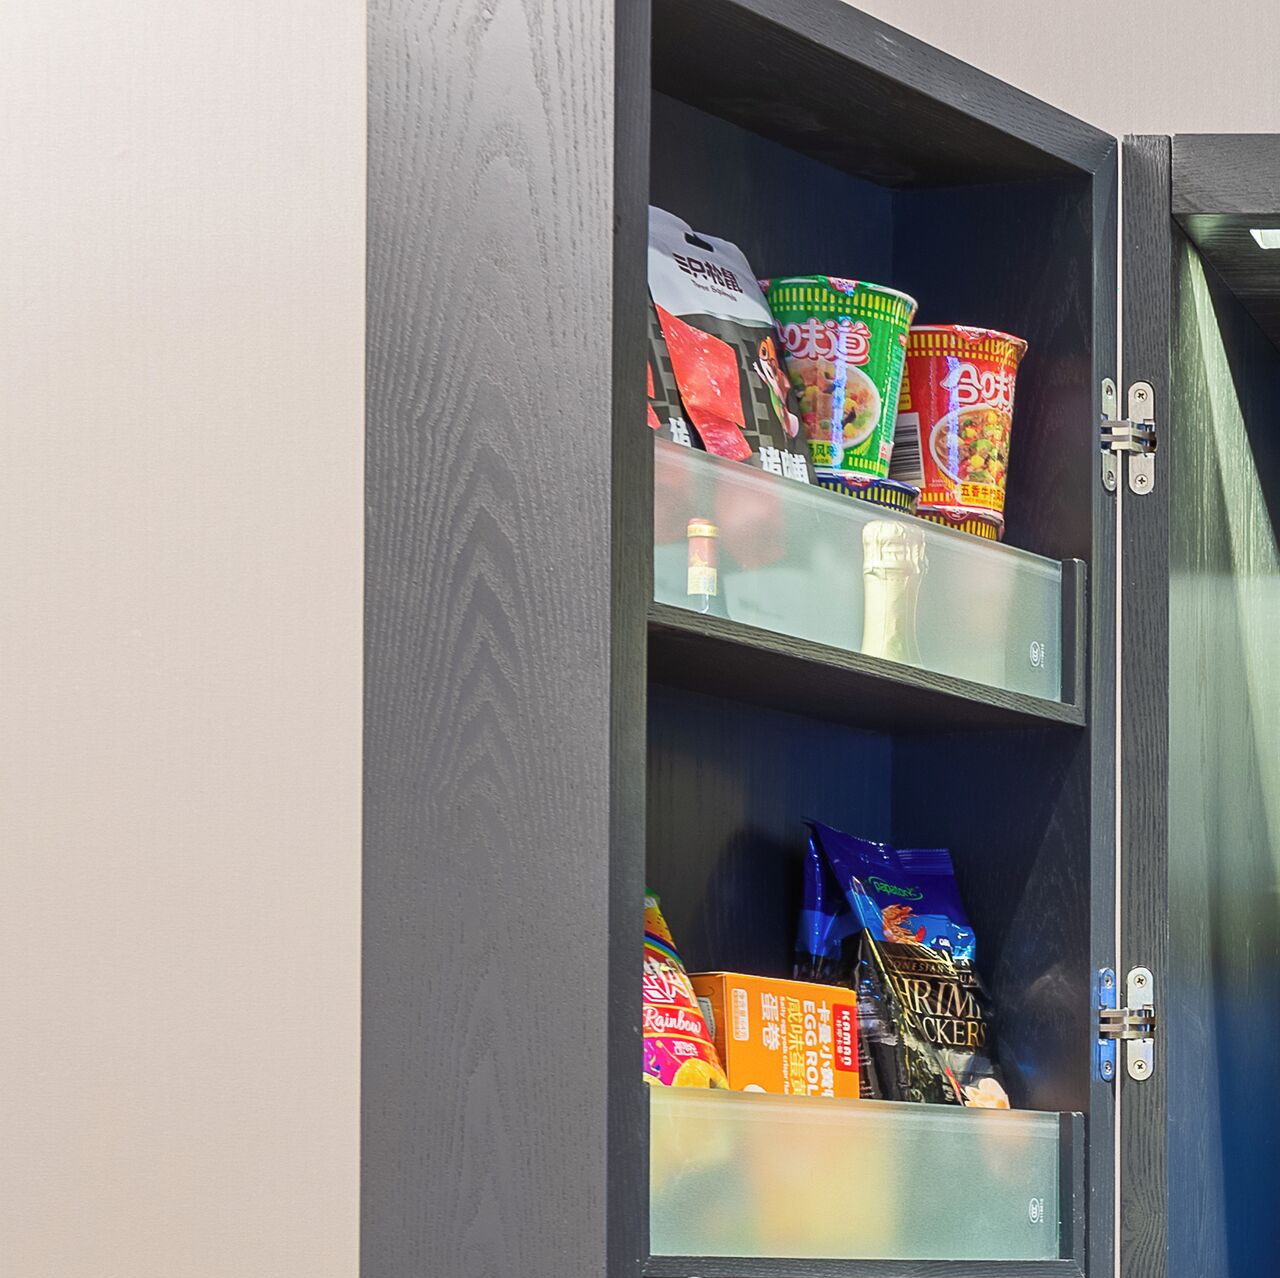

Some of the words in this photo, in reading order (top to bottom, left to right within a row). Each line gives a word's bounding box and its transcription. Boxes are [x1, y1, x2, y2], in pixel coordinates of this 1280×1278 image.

[672, 252, 743, 293] 三只松鼠
[776, 317, 872, 367] 味道
[941, 362, 1014, 412] 合味
[643, 1006, 701, 1033] Rainbow
[761, 992, 780, 1051] 蛋卷
[803, 1000, 817, 1046] EGG
